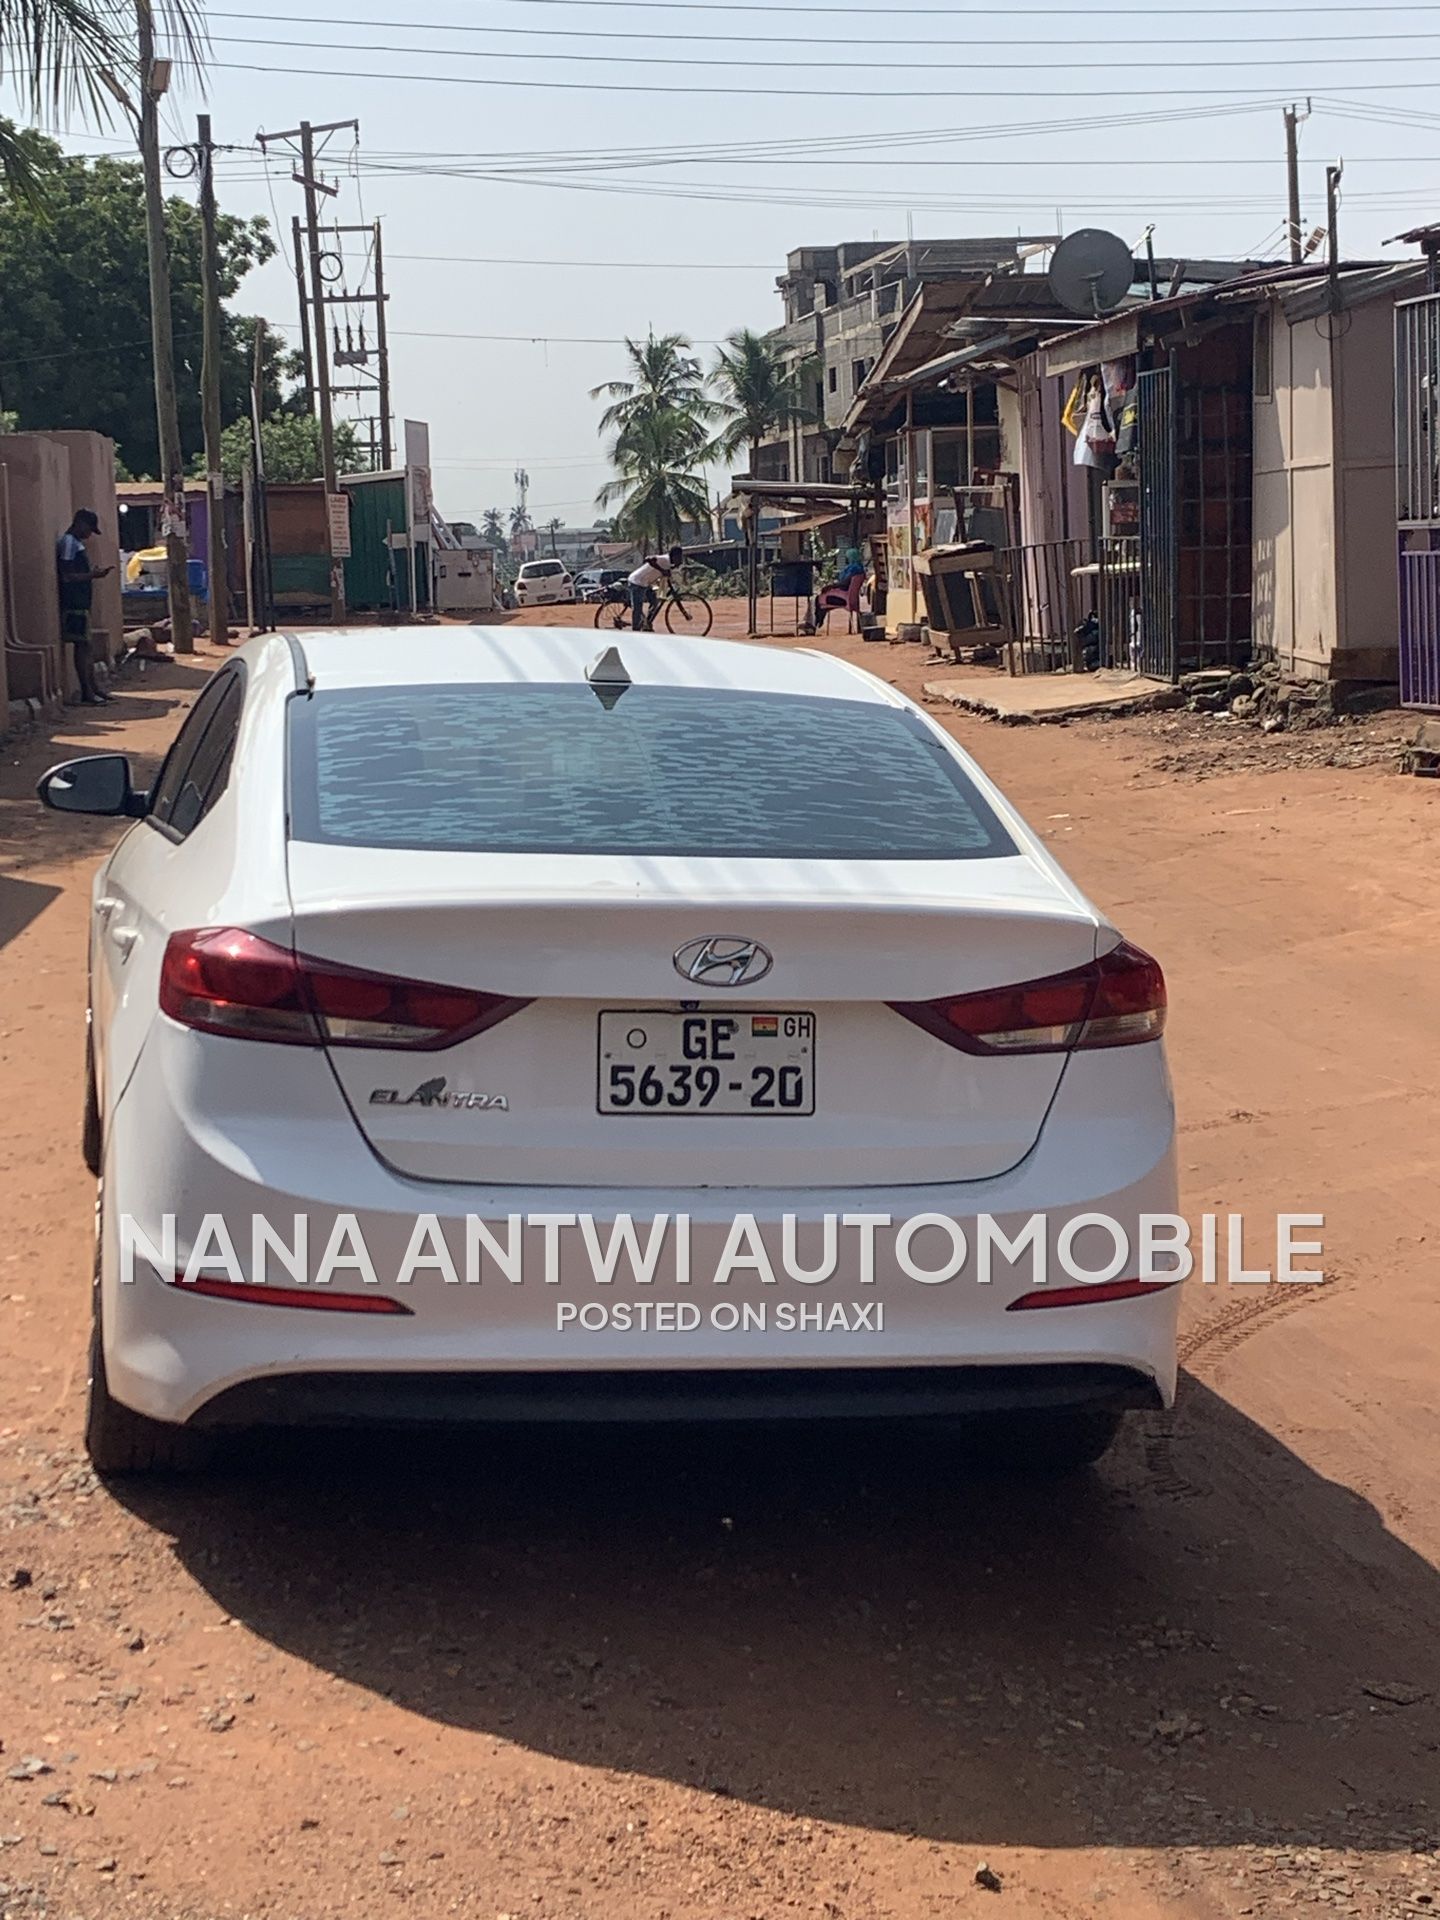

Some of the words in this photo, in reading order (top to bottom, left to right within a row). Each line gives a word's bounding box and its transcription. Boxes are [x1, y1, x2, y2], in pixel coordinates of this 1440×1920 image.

[682, 1018, 735, 1060] GE
[783, 1016, 811, 1038] GH
[369, 1088, 510, 1112] ELANTRA
[610, 1064, 804, 1107] 5639-20
